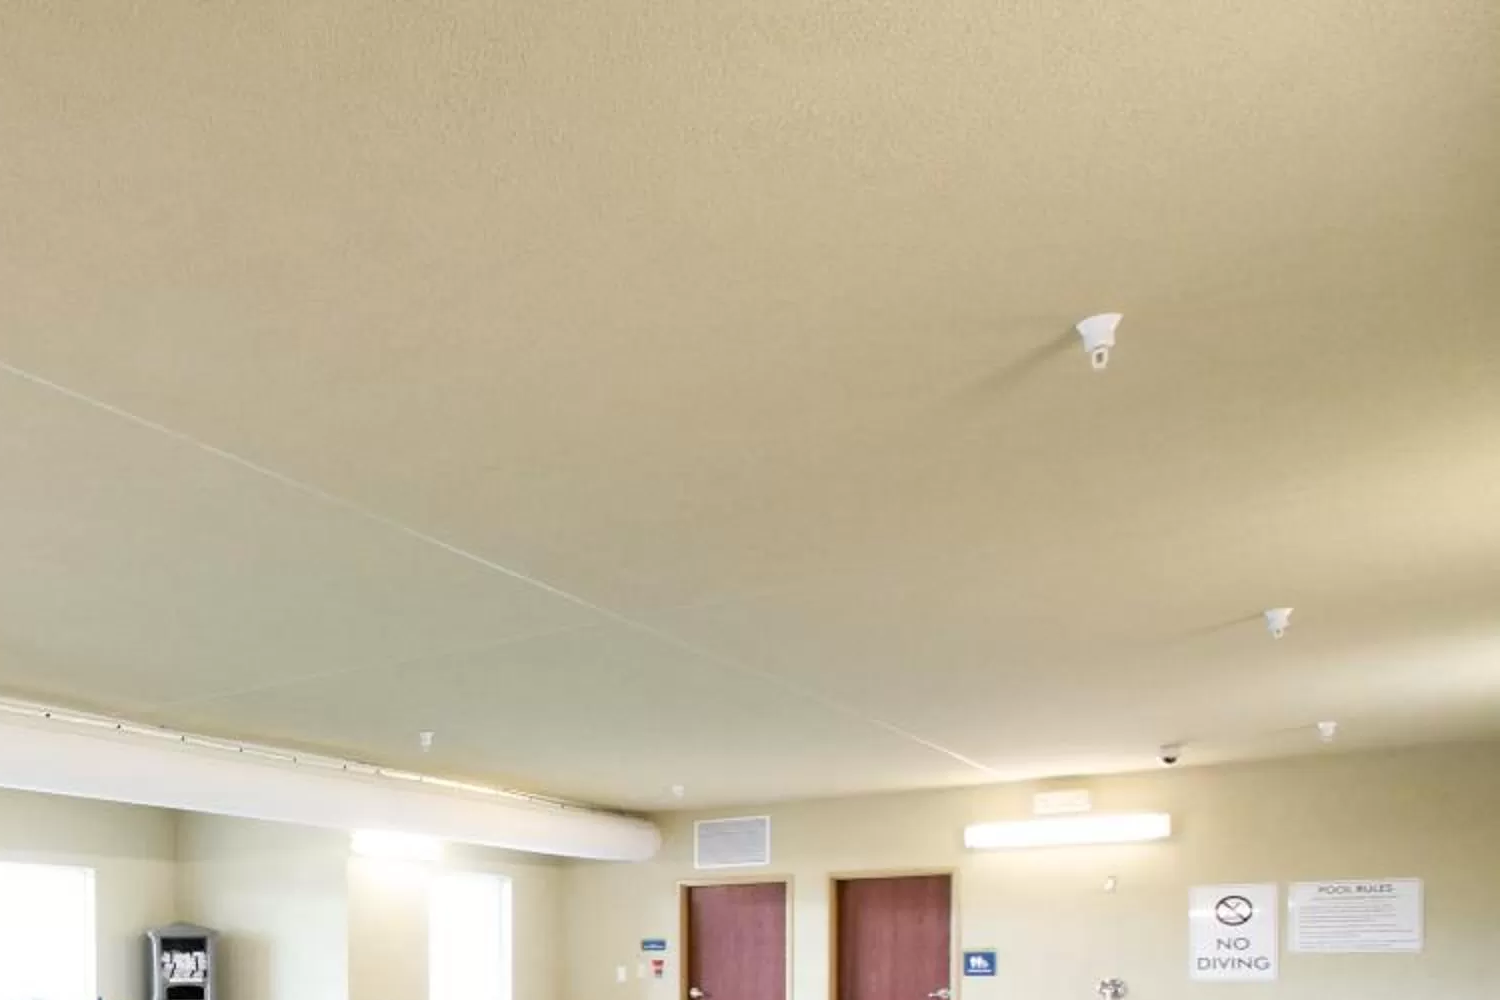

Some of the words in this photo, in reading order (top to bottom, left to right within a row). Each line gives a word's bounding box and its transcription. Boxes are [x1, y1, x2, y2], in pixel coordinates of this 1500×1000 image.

[1318, 884, 1353, 895] POOL
[1356, 883, 1394, 893] RULES
[1216, 937, 1251, 951] NO
[1197, 956, 1271, 971] DIVING
